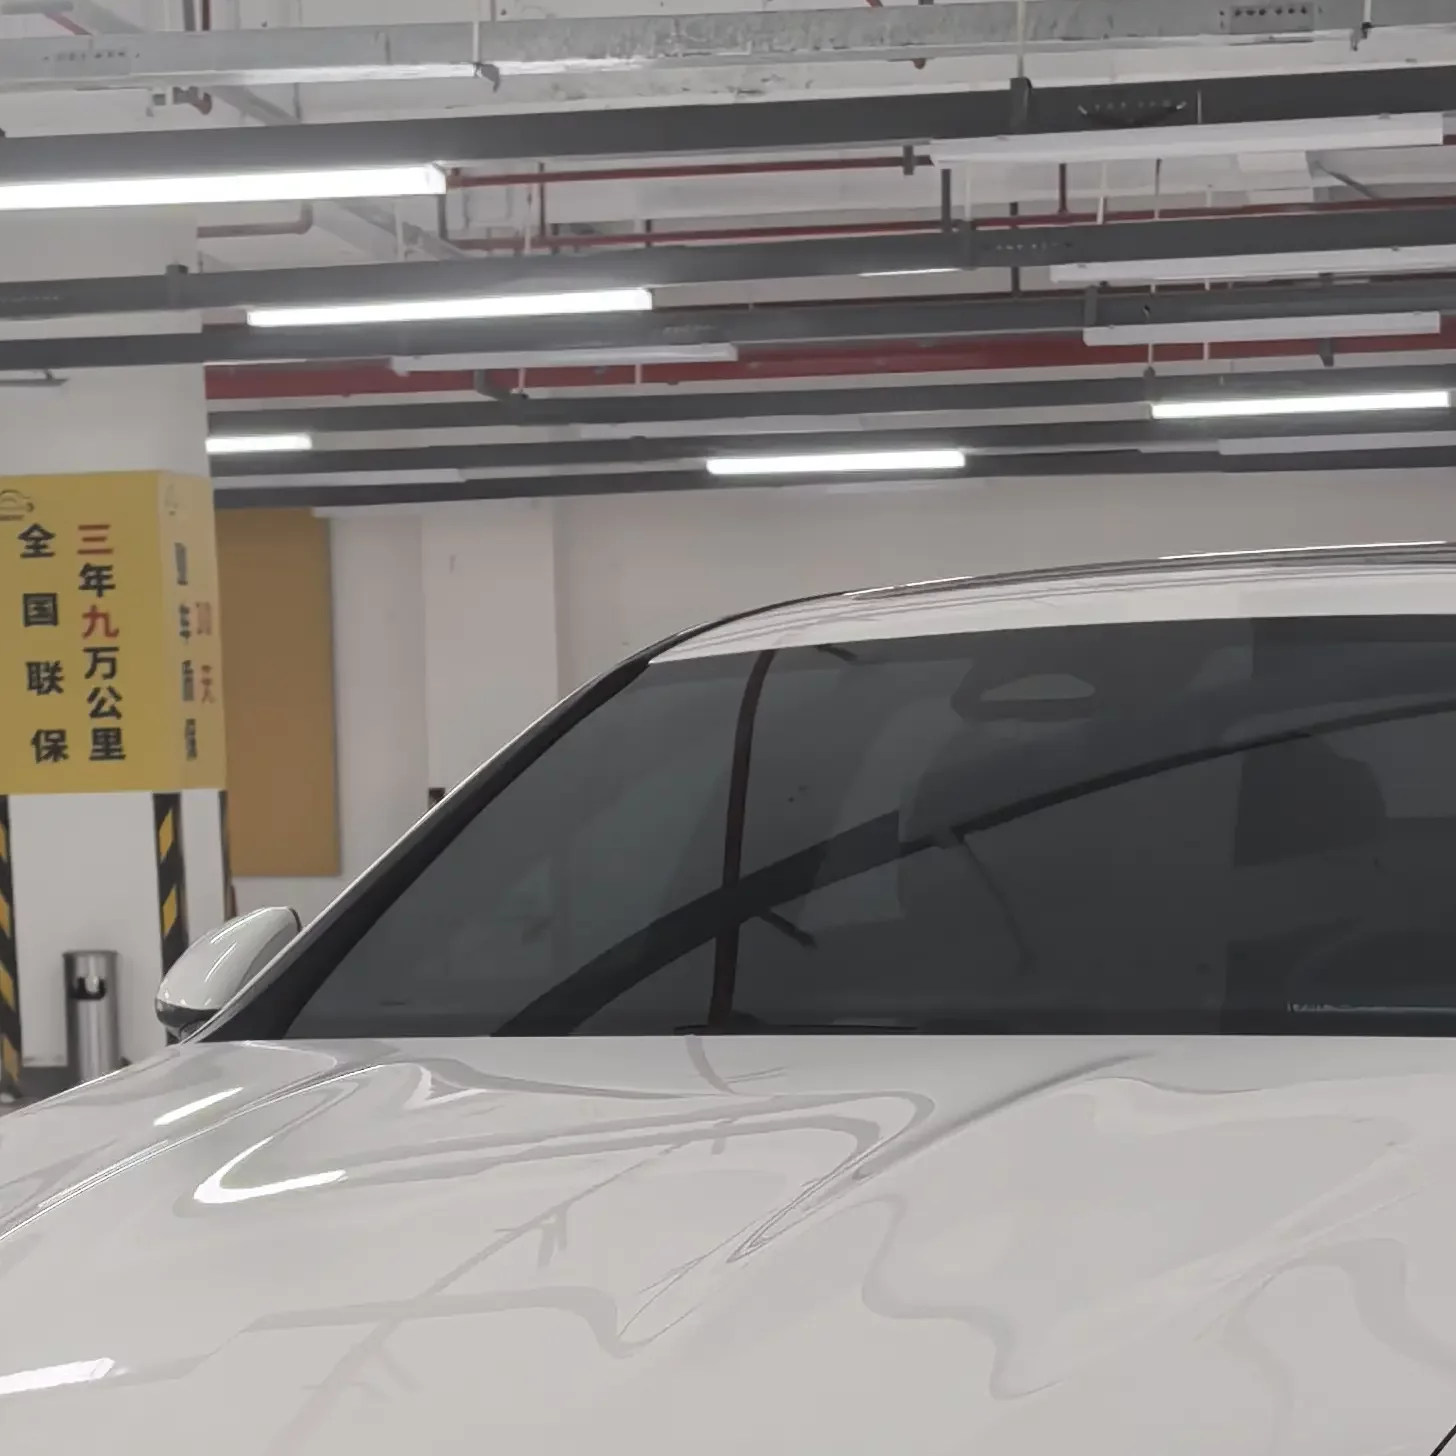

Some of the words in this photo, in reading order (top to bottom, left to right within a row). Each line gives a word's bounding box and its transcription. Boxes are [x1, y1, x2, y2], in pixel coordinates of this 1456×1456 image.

[18, 524, 69, 763] 全国联保
[77, 524, 126, 761] 三年九万公里
